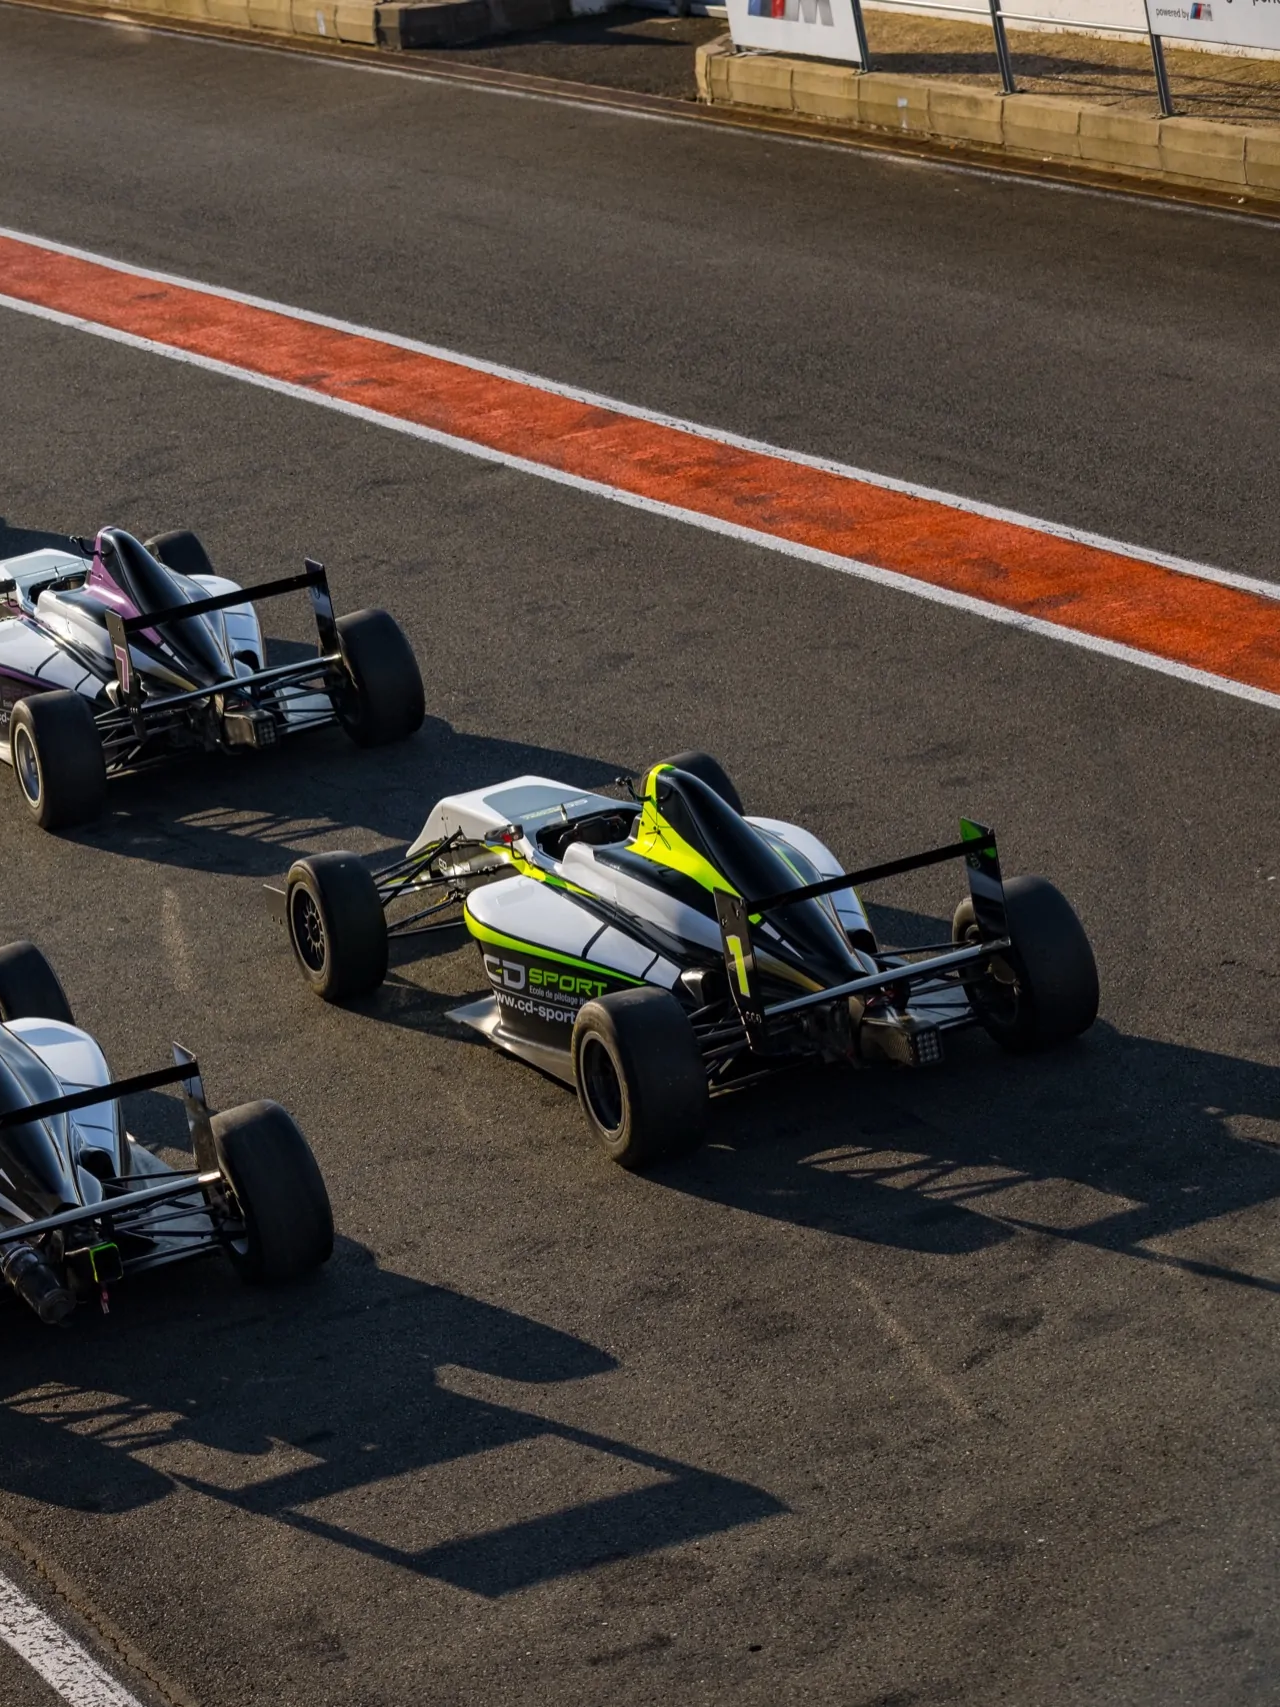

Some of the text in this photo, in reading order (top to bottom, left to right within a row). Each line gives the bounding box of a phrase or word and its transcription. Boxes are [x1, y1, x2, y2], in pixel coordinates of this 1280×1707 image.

[1156, 8, 1181, 18] powered
[1181, 9, 1189, 20] by
[114, 644, 130, 694] 7
[484, 954, 608, 998] CD SPORT
[726, 935, 751, 998] 1
[529, 985, 545, 998] Ecole
[545, 989, 553, 1000] de
[554, 991, 578, 1006] pilotage
